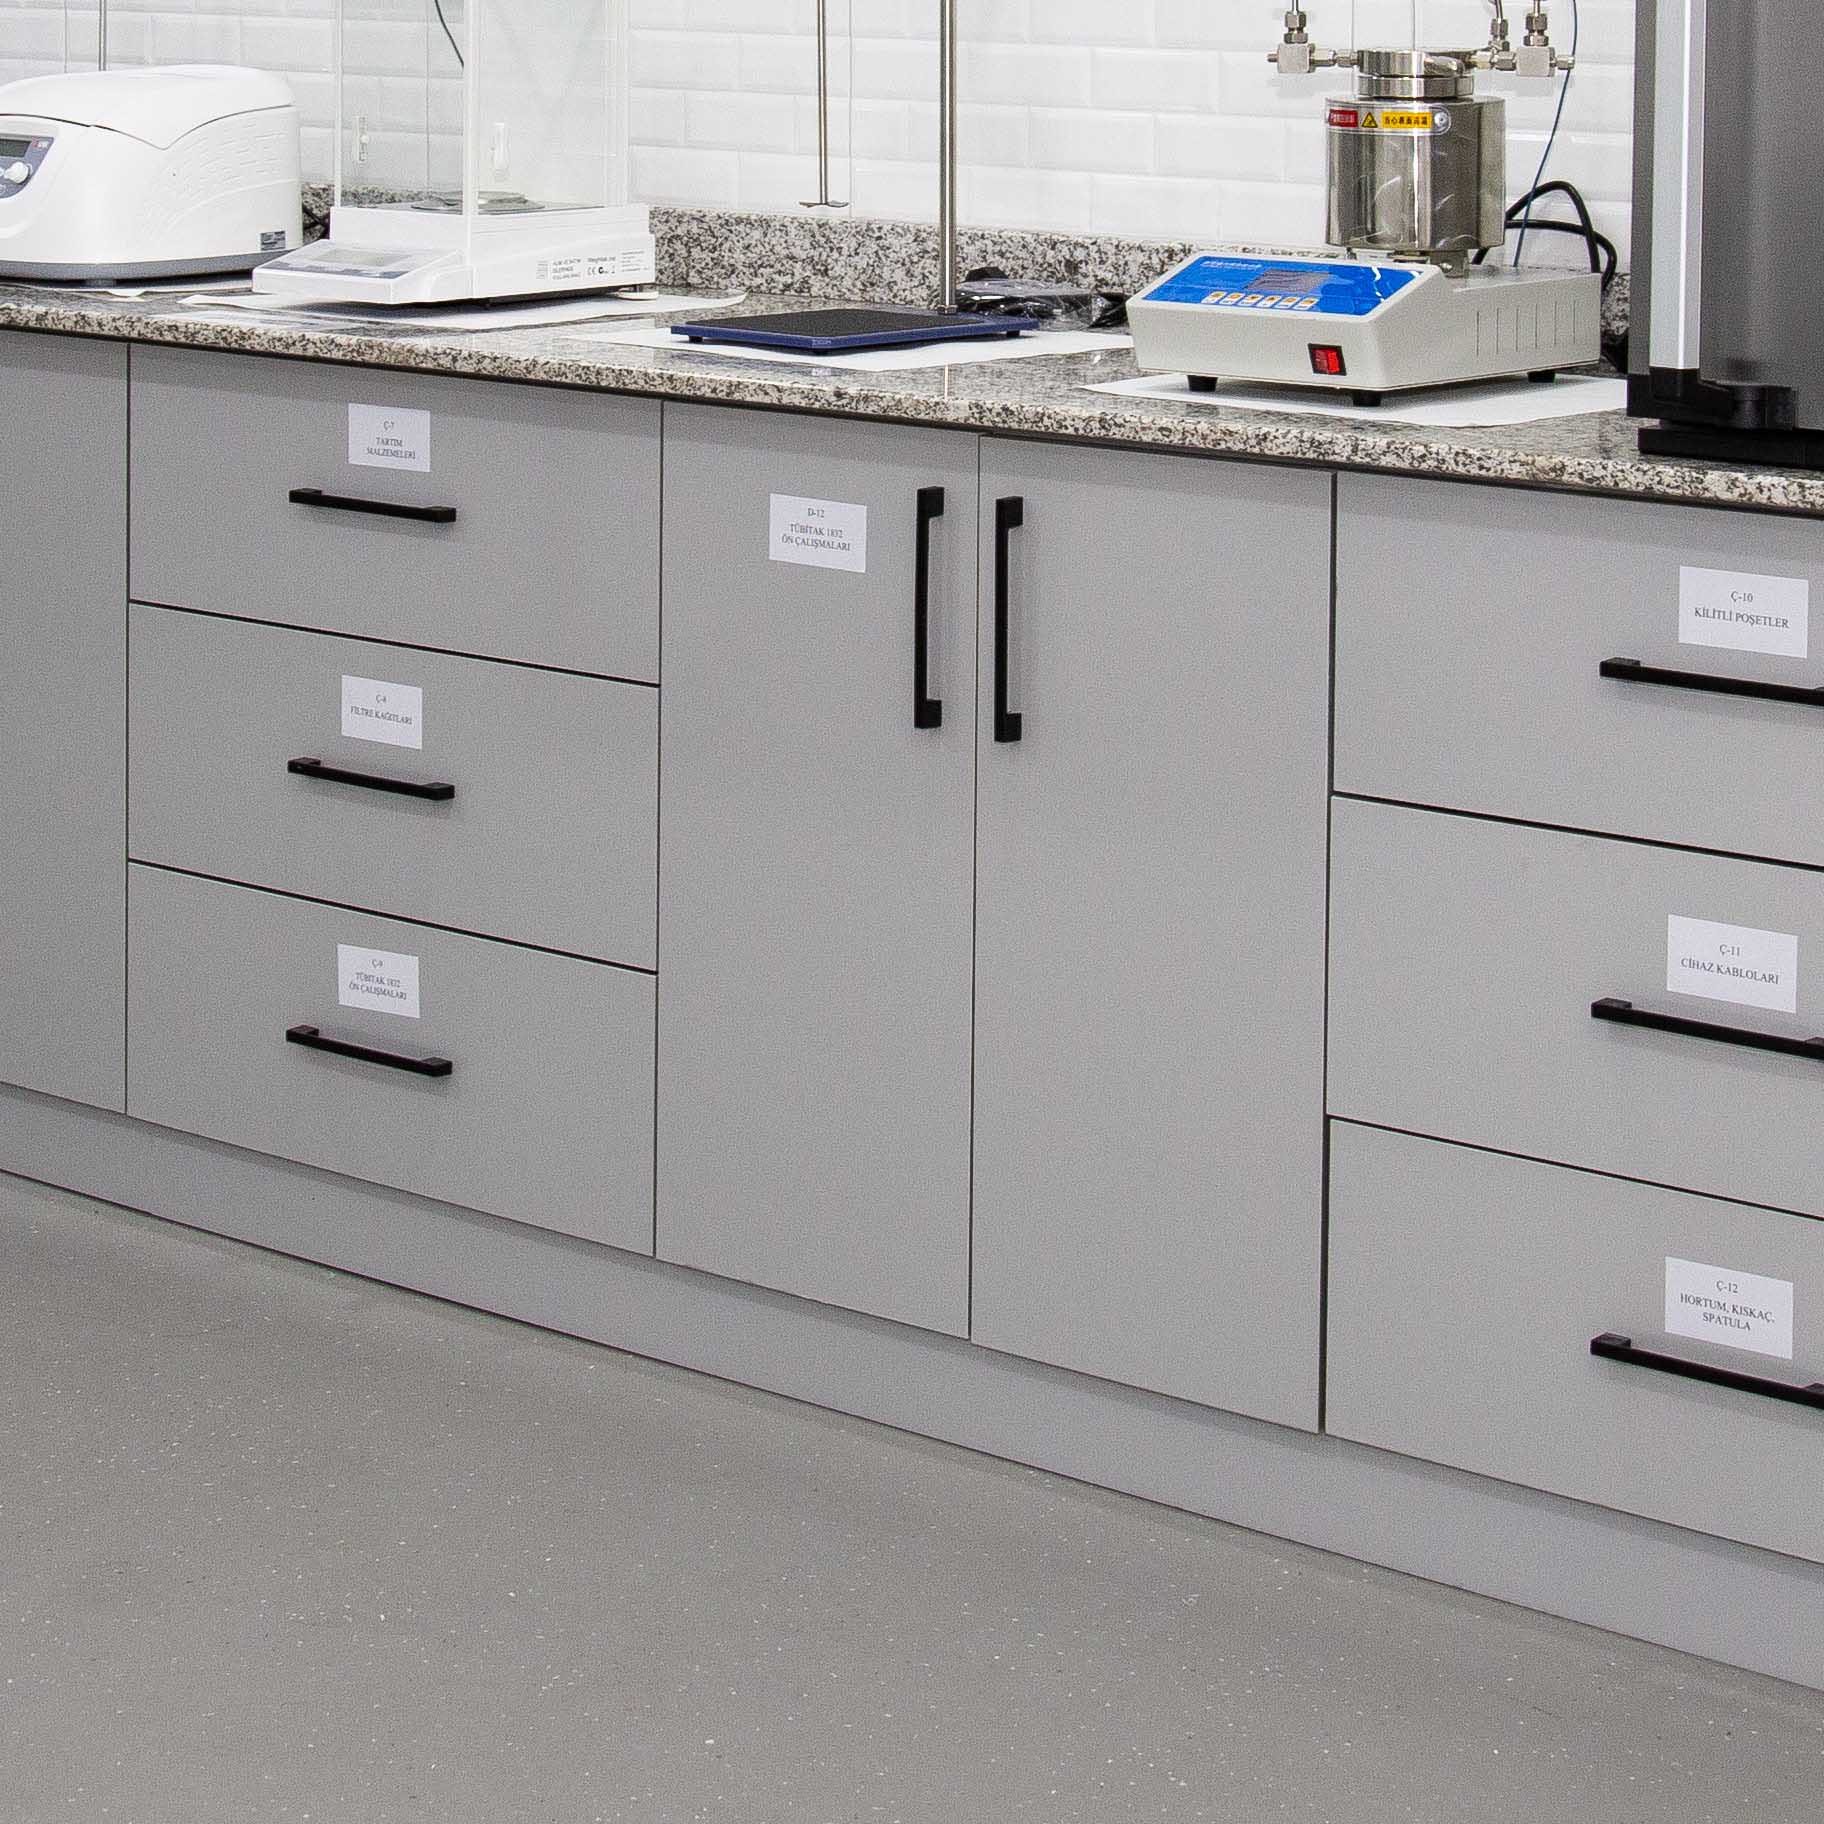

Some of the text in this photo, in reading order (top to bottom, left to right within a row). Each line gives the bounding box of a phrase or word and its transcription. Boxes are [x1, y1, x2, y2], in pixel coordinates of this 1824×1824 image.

[790, 522, 825, 537] TÜBİTAK
[794, 536, 850, 552] ÇALIŞMALARI
[1730, 591, 1753, 603] Ç-10
[1694, 606, 1789, 629] KİLİTLİ POŞETLER
[1719, 944, 1740, 957] Ç-11
[1680, 957, 1779, 985] CİHAZ KABLOLARI
[1716, 1280, 1738, 1294] Ç-12
[1702, 1312, 1751, 1331] SPATULA
